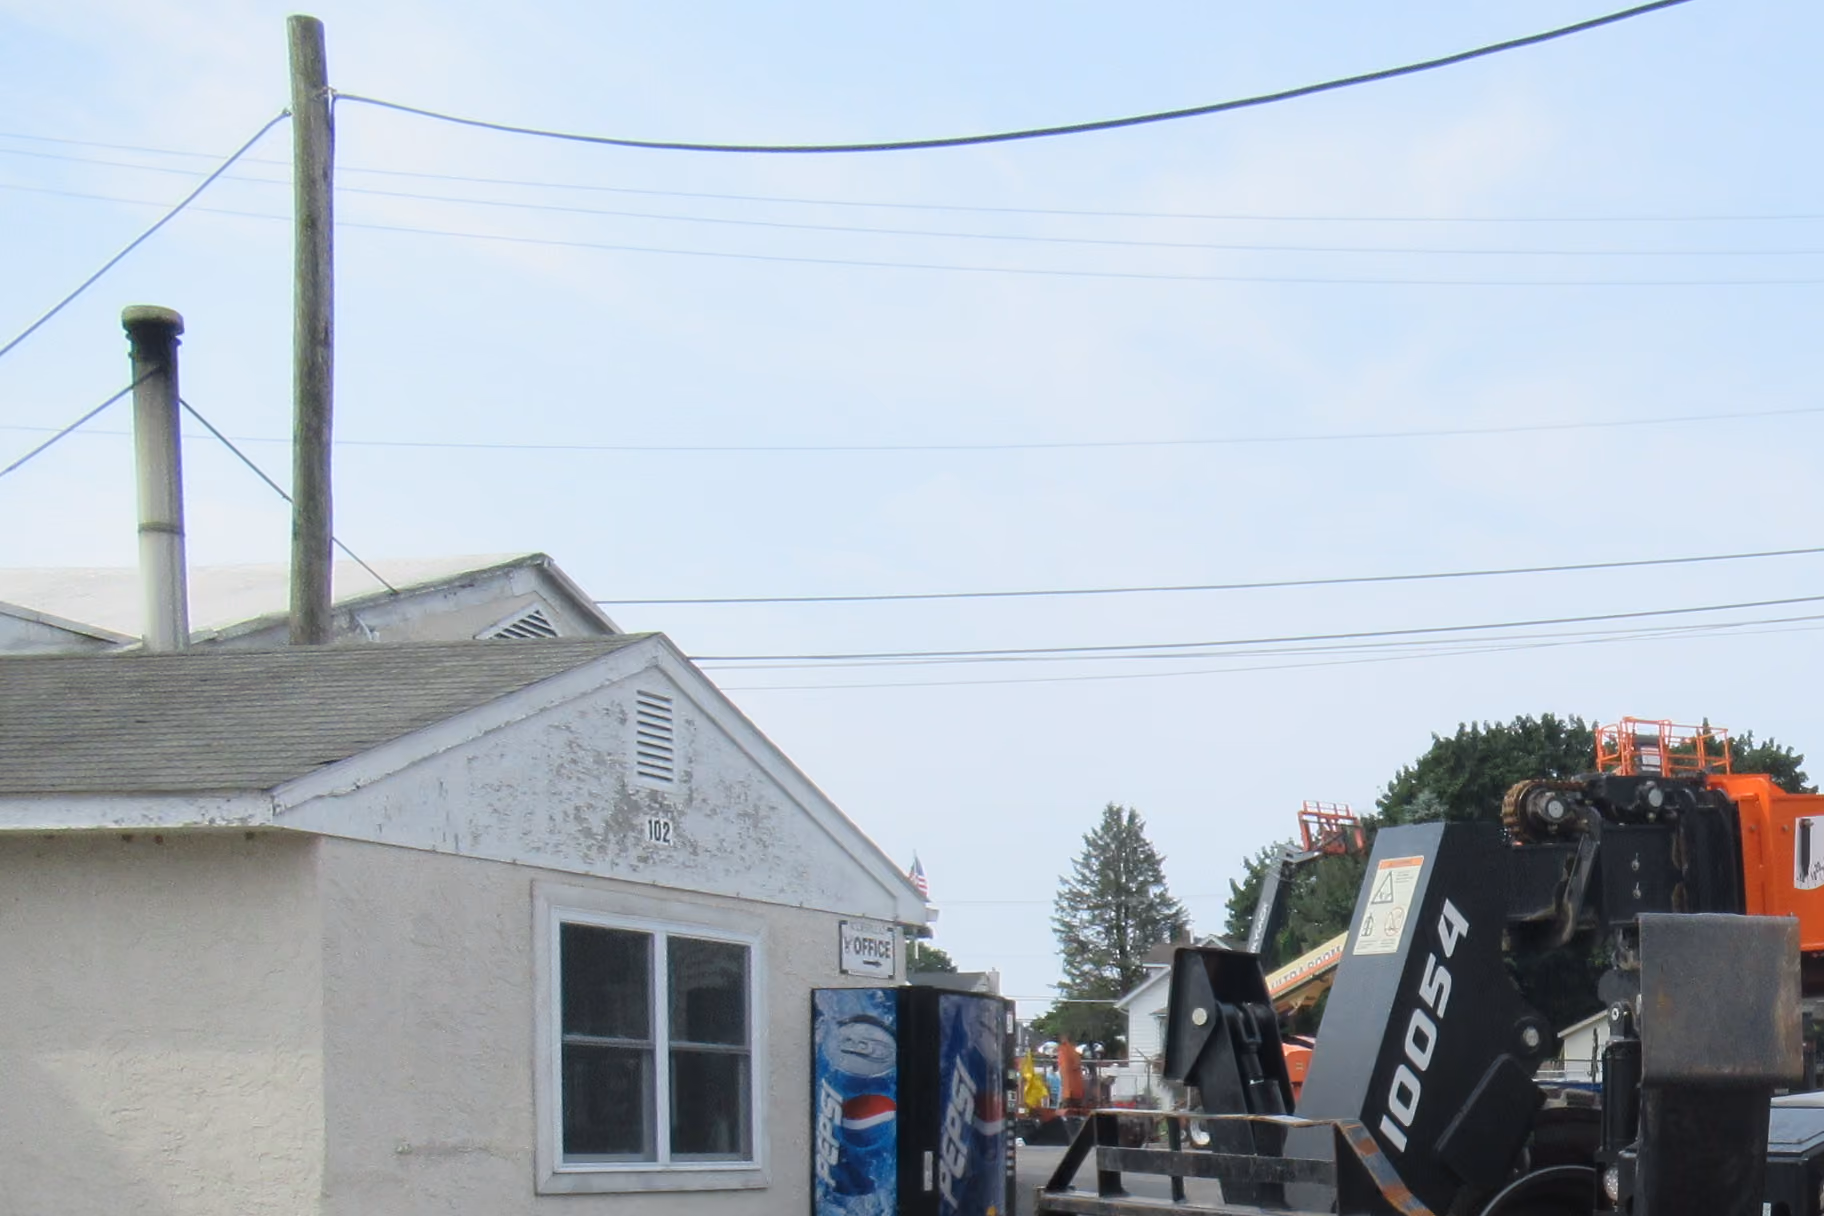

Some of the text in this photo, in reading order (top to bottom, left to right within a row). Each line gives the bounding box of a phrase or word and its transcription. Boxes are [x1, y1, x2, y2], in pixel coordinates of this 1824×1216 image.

[647, 819, 671, 843] 102
[853, 936, 891, 959] OFFICE
[1379, 898, 1470, 1153] 10054
[815, 1078, 843, 1188] PEPSI
[940, 1054, 977, 1209] PEPSI
